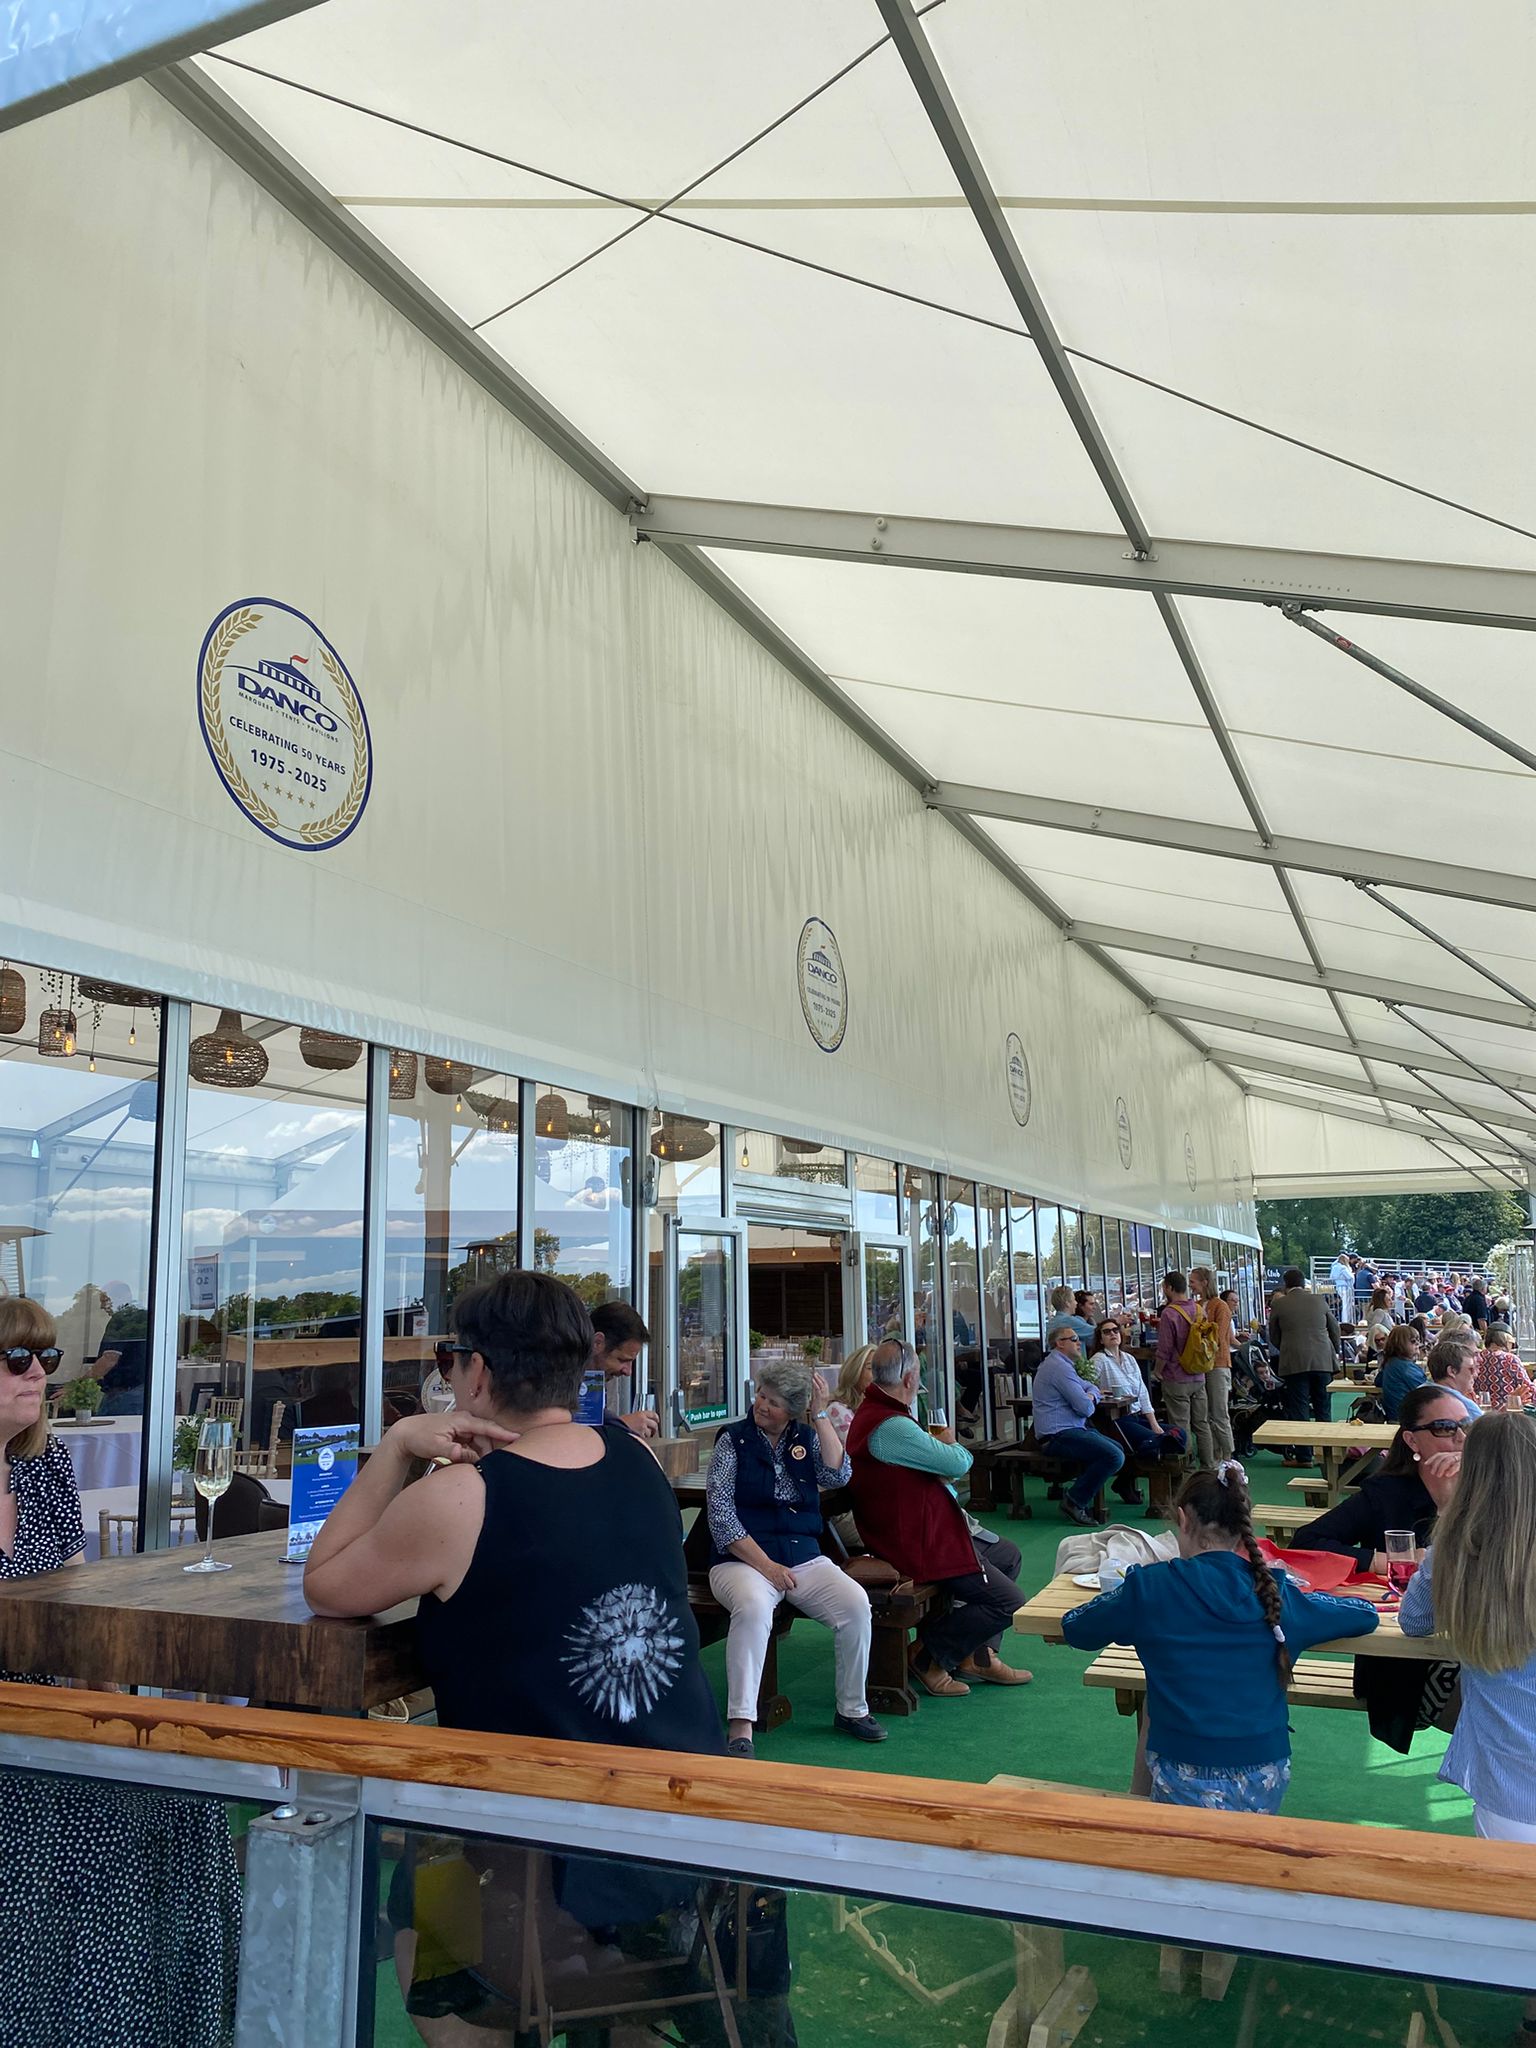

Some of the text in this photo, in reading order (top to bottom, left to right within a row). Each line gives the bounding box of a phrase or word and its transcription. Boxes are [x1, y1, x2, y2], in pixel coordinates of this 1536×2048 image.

[238, 673, 338, 732] DANCO
[238, 692, 339, 743] MARQUEES TENTS PAVILIONS
[229, 716, 346, 775] CELEBRATING 50 YEARS
[808, 962, 837, 984] DANCO
[690, 1412, 702, 1421] Push
[711, 1410, 715, 1418] to
[716, 1410, 726, 1418] open
